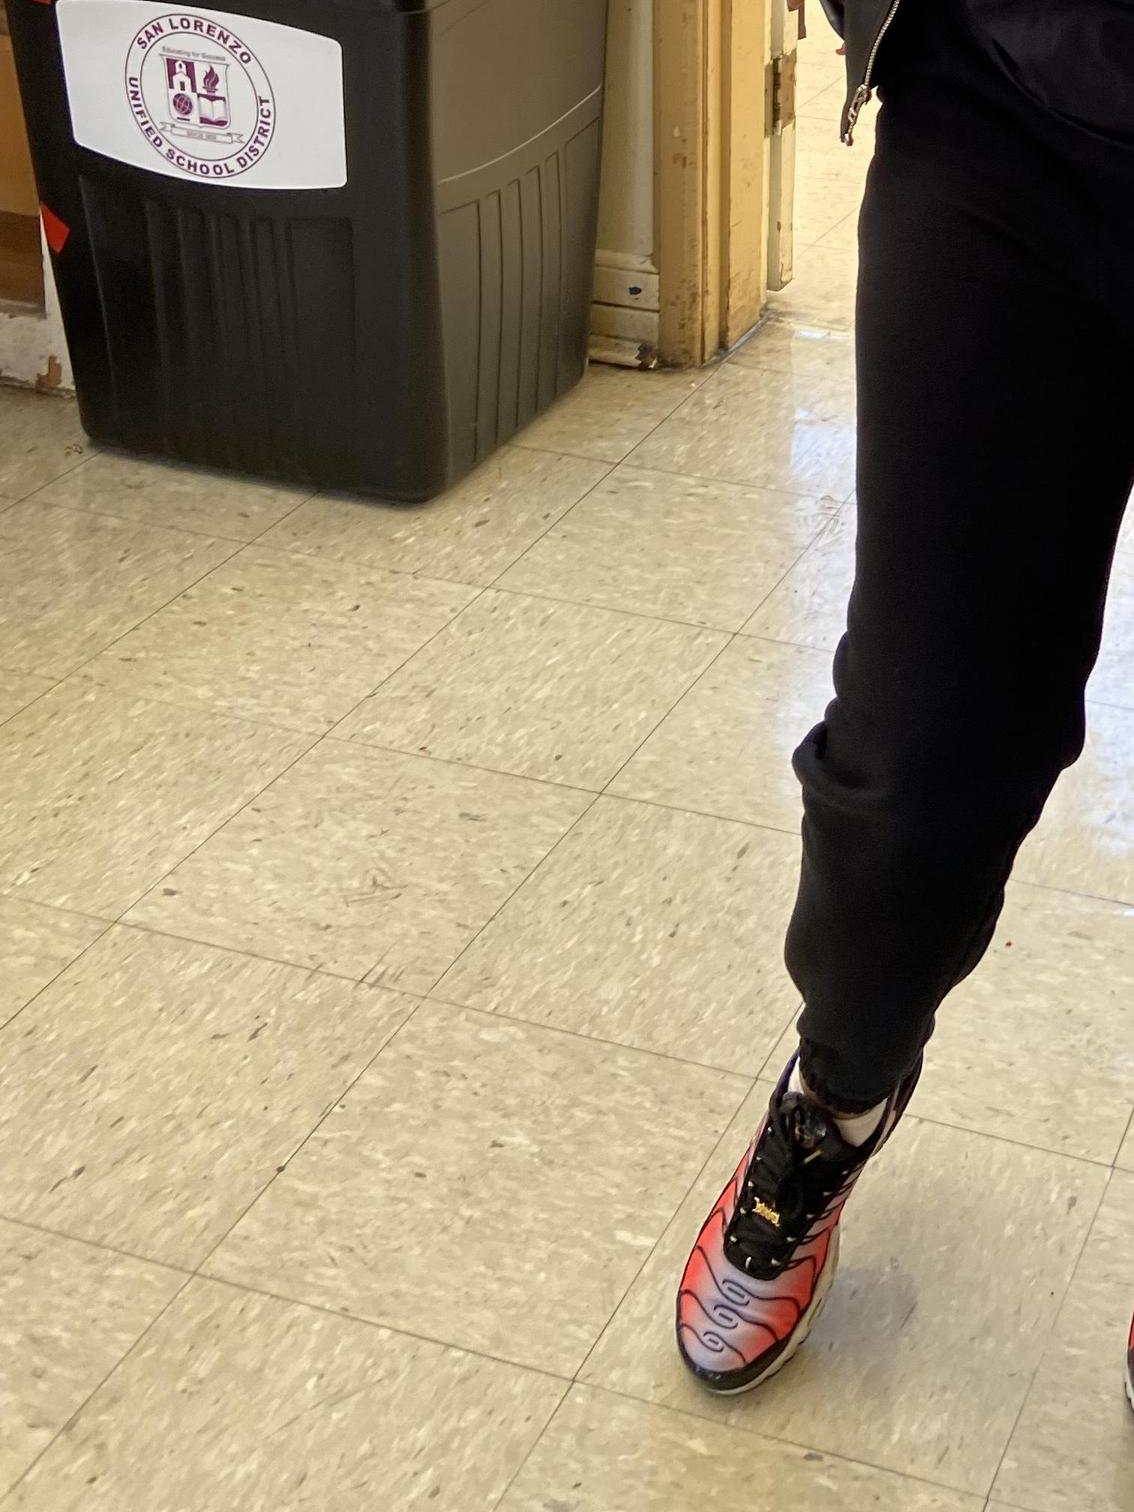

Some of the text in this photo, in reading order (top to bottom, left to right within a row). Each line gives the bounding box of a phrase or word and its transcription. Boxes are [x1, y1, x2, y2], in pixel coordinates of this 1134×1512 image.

[136, 17, 252, 65] SAN LORENZO
[128, 76, 272, 177] UNIFIED SCHOOL DISTRICT
